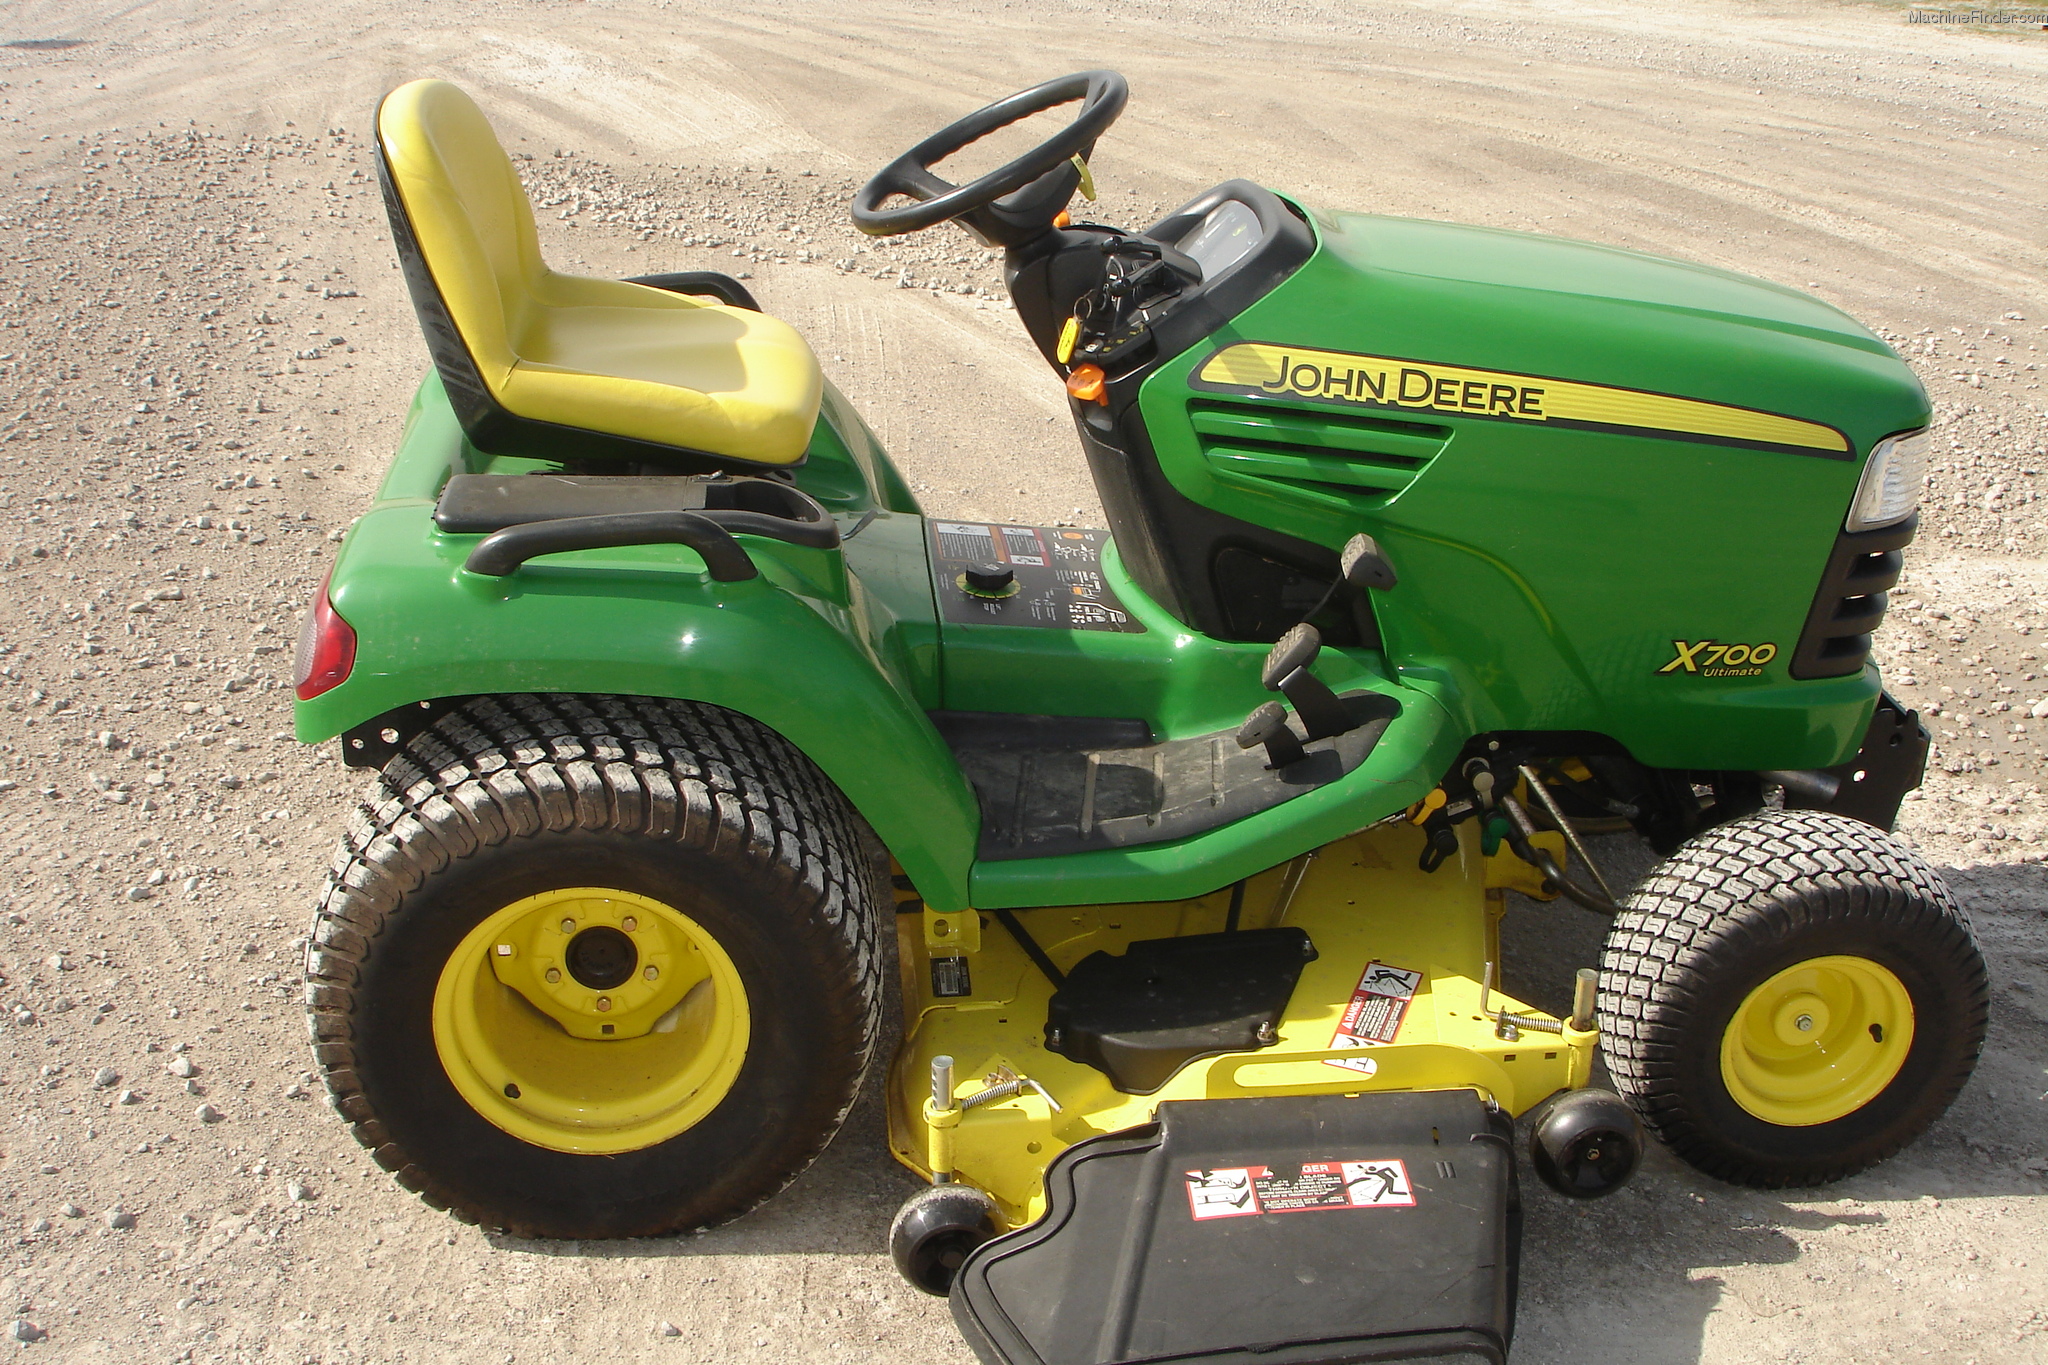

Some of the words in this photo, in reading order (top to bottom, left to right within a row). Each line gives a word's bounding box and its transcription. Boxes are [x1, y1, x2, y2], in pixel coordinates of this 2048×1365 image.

[1262, 355, 1387, 399] JOHN
[1398, 367, 1546, 416] DEERE
[1657, 640, 1777, 673] X700
[1703, 667, 1762, 677] Ultimate
[1345, 995, 1364, 1025] DANGER
[1301, 1164, 1329, 1173] GER
